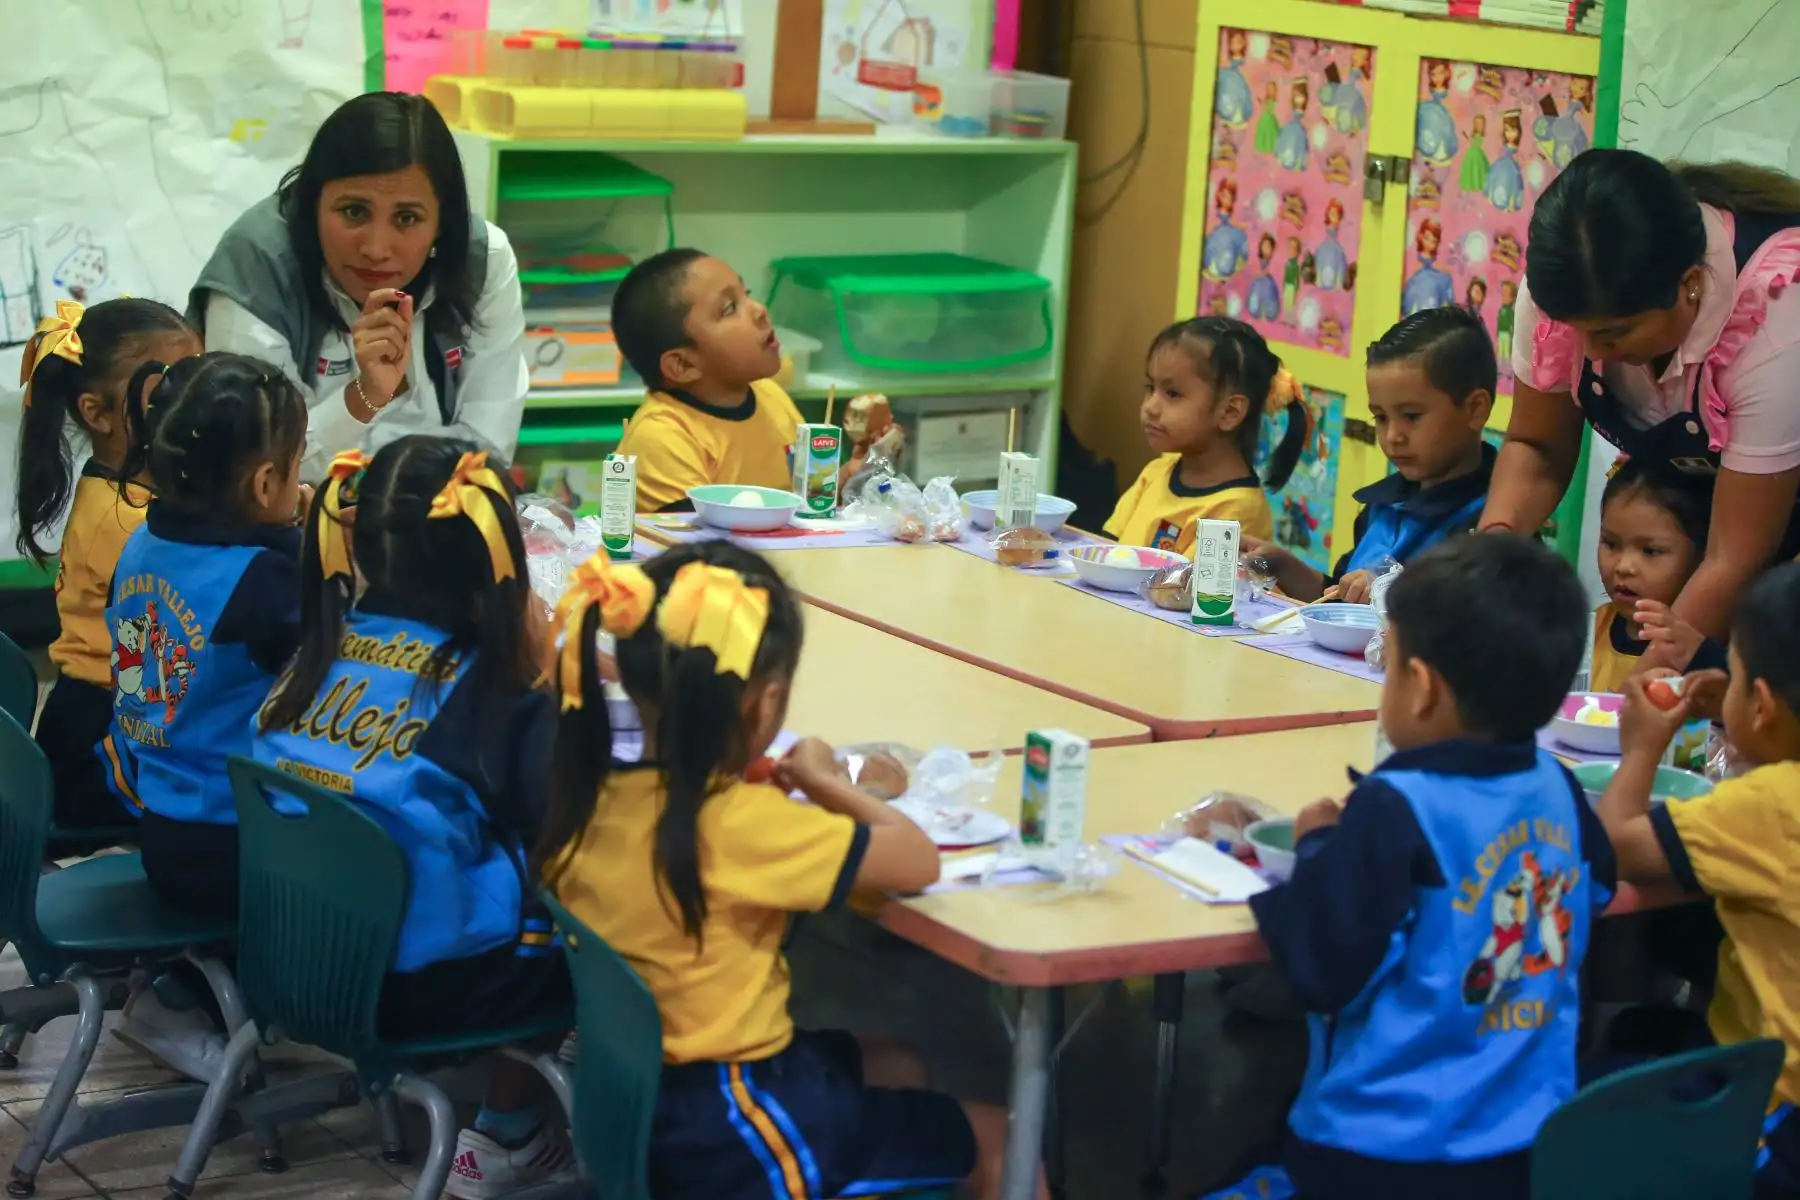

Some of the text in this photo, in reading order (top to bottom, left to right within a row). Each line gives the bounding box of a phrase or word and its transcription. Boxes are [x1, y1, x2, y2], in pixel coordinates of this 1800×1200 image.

[812, 438, 835, 447] LAIVE
[117, 573, 205, 652] ESAR VALLEJO
[257, 670, 428, 773] llejo
[294, 762, 354, 793] VICTORIA
